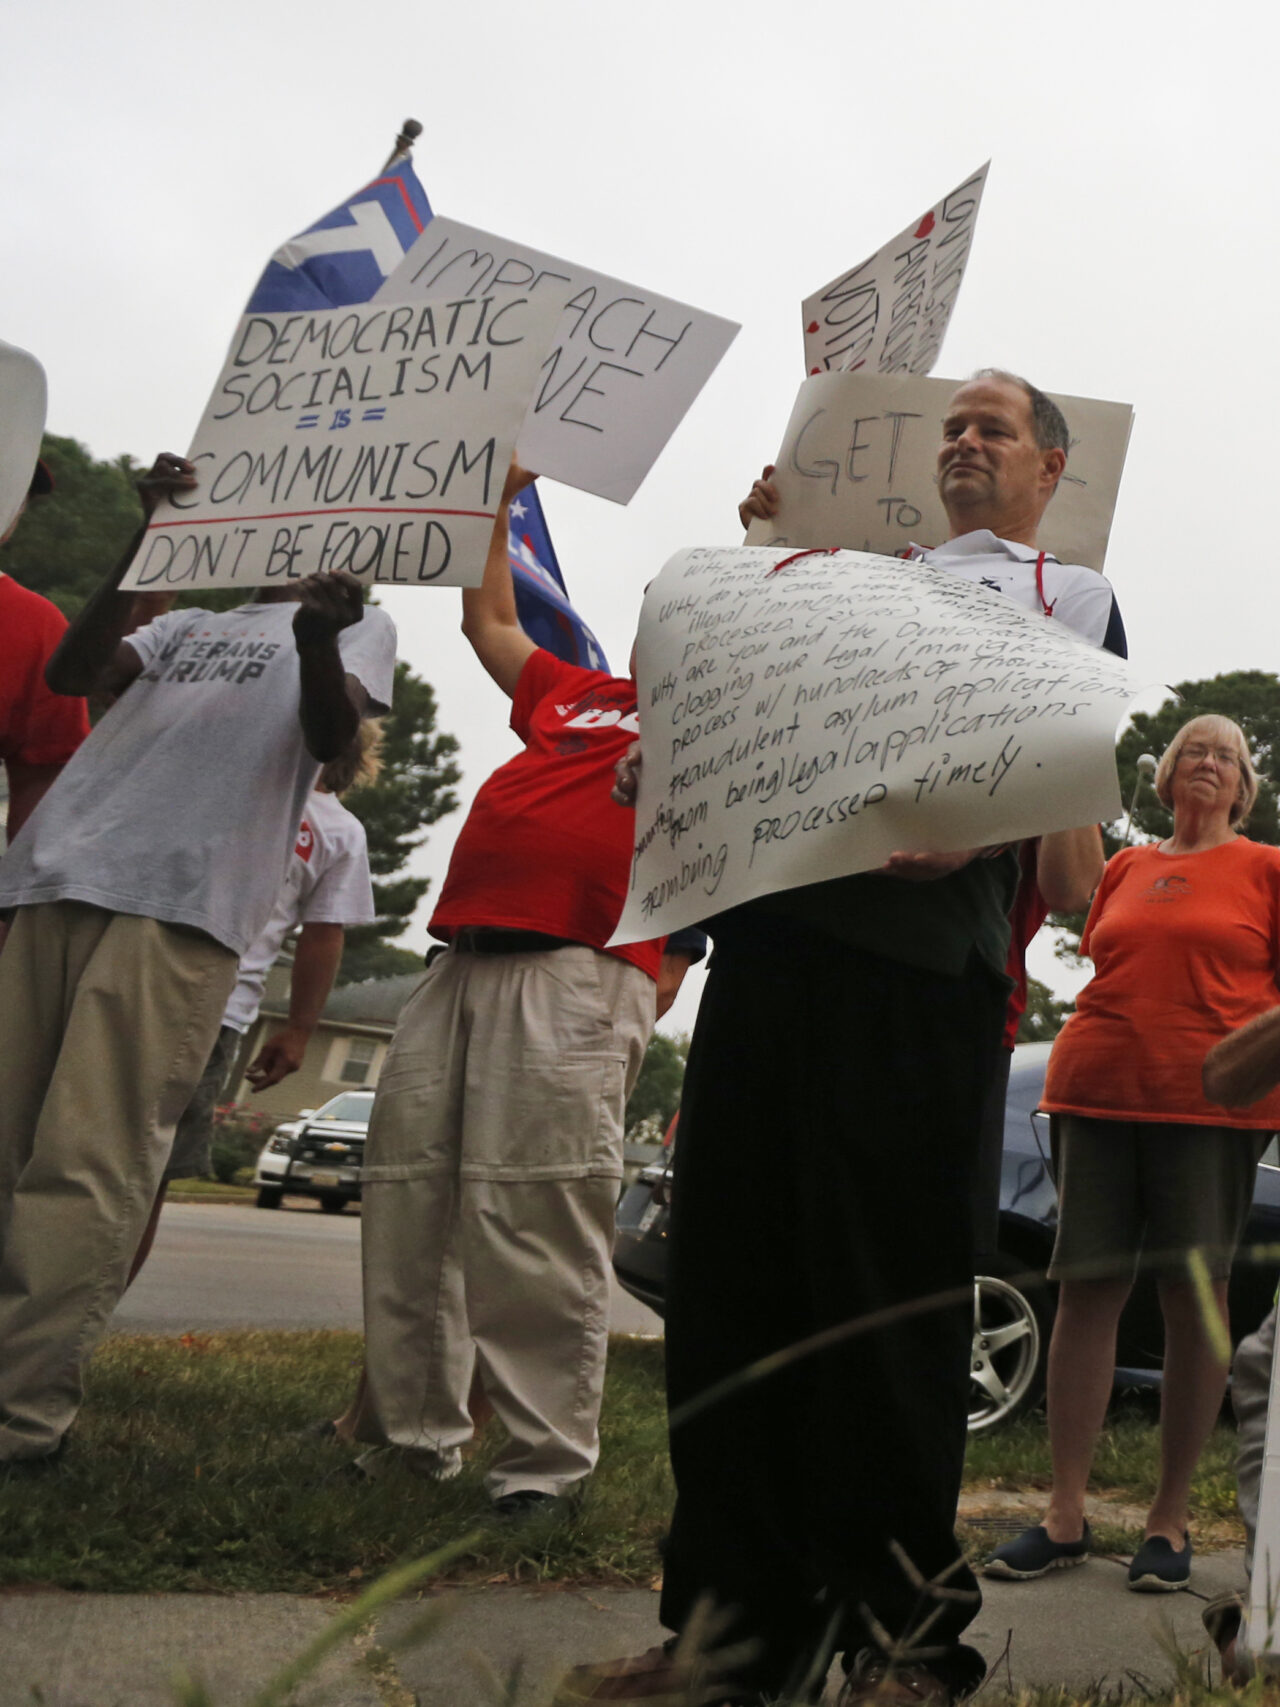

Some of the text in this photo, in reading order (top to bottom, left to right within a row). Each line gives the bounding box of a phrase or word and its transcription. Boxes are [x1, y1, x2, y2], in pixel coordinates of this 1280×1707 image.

[233, 298, 528, 367] DEMOCRATIC
[213, 352, 492, 419] SOCIALISM
[168, 437, 496, 510] COMMUNISM
[790, 408, 924, 496] GET
[877, 497, 922, 527] TO
[136, 521, 451, 586] DON'T BE FOOLED
[154, 660, 266, 684] RUMP
[160, 640, 281, 661] VERANS
